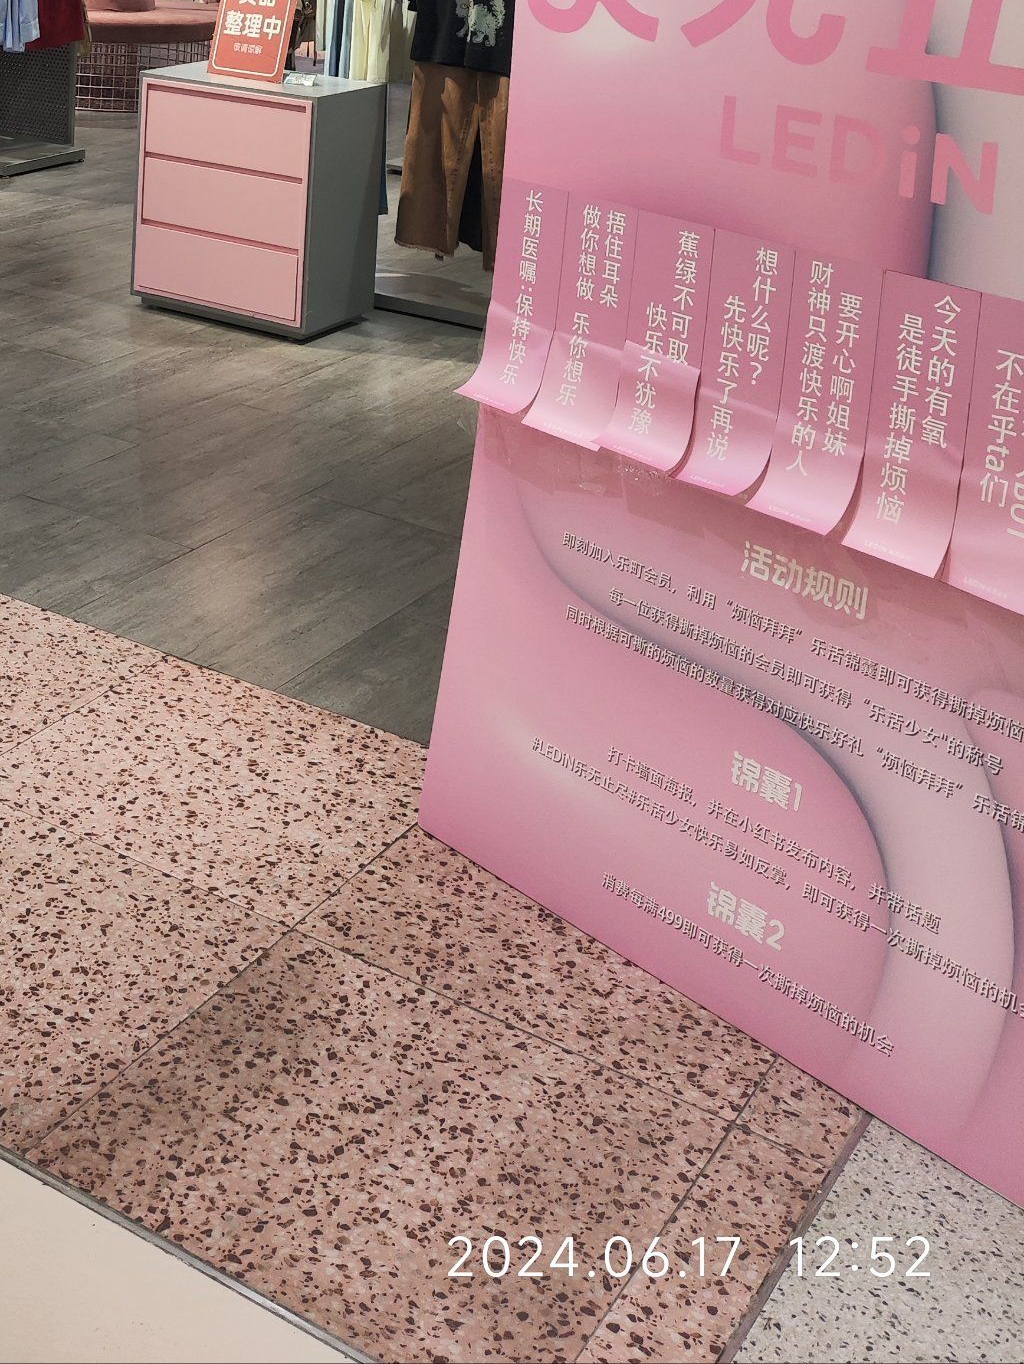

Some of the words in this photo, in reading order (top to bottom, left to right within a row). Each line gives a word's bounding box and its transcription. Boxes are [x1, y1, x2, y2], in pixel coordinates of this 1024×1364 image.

[223, 9, 282, 40] 整理中
[720, 95, 999, 215] LEDiN
[599, 210, 626, 309] 捂住耳朵
[666, 230, 700, 365] 蕉绿不可取
[627, 302, 667, 437] 快乐不犹豫
[705, 294, 747, 462] 先快乐了再说
[785, 260, 835, 477] 财神只渡快乐的人
[822, 291, 864, 457] 要开心啊姐妹
[875, 313, 926, 525] 是徒手撕掉烦恼
[921, 294, 961, 449] 今天的有氧
[739, 540, 869, 621] 活动规则
[730, 751, 803, 812] 锦囊1
[706, 882, 786, 953] 锦囊2
